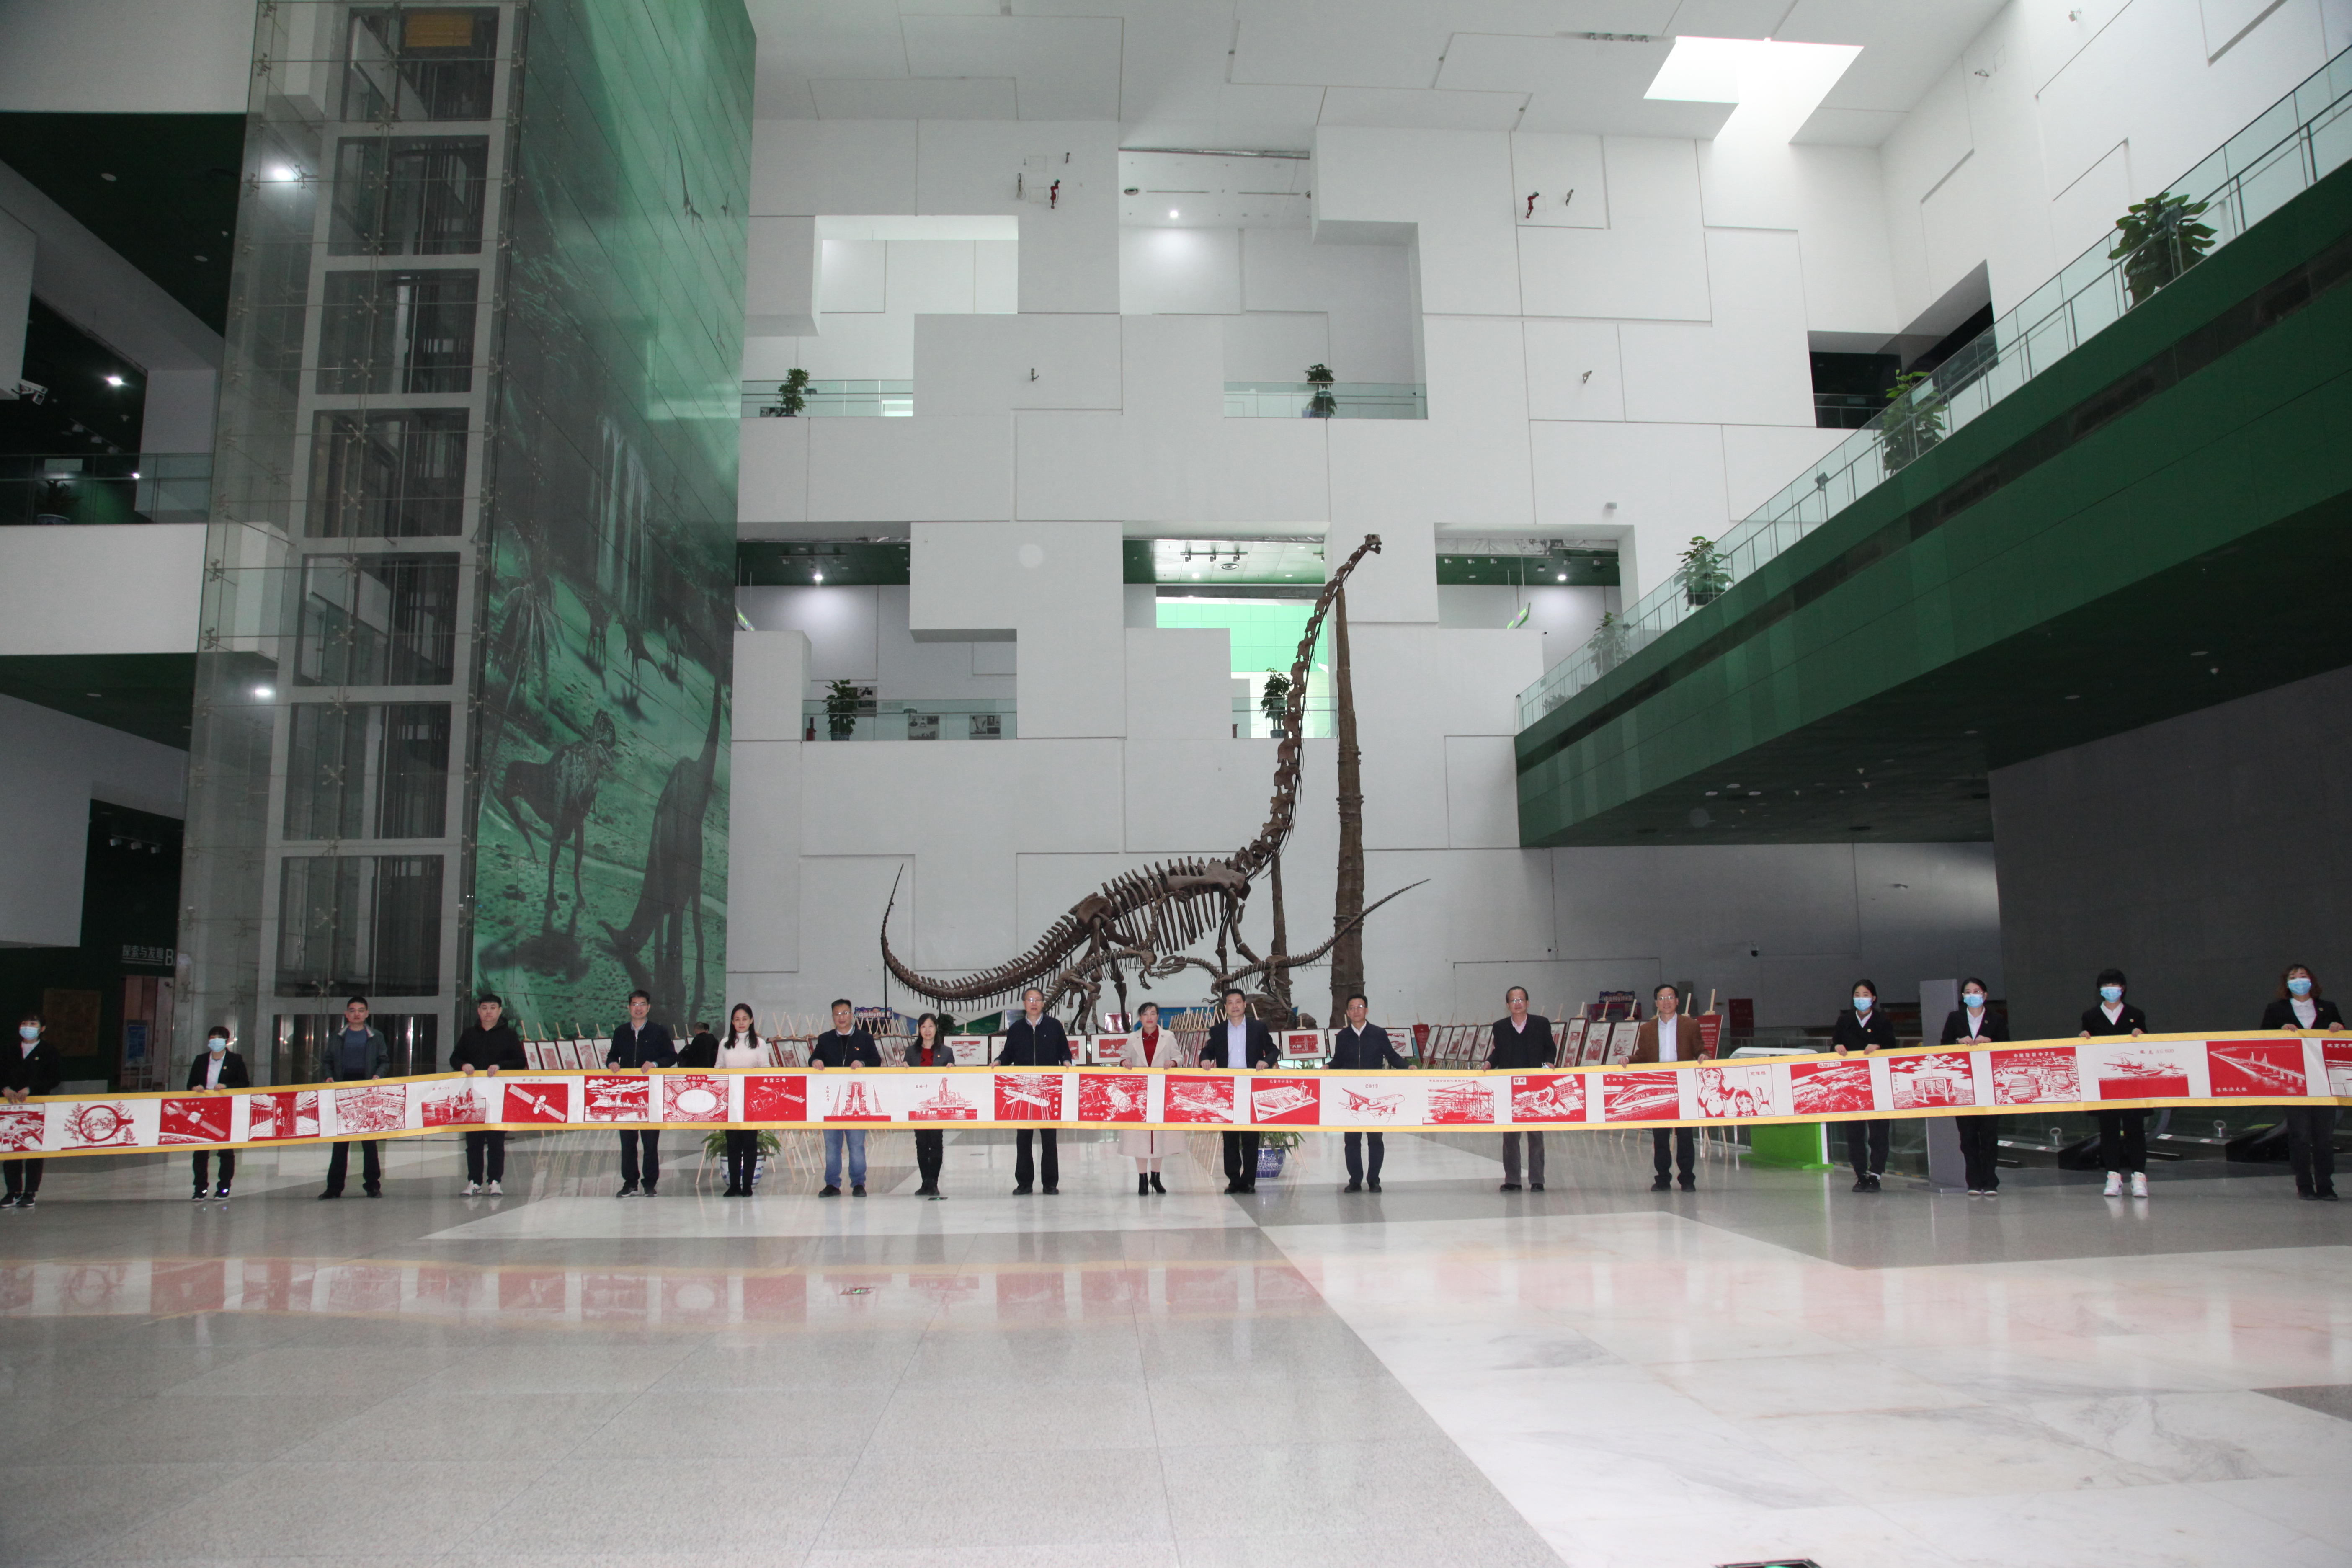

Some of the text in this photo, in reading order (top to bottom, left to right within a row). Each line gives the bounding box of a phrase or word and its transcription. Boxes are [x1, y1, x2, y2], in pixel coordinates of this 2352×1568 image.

[122, 944, 174, 966] 探索与发现 B
